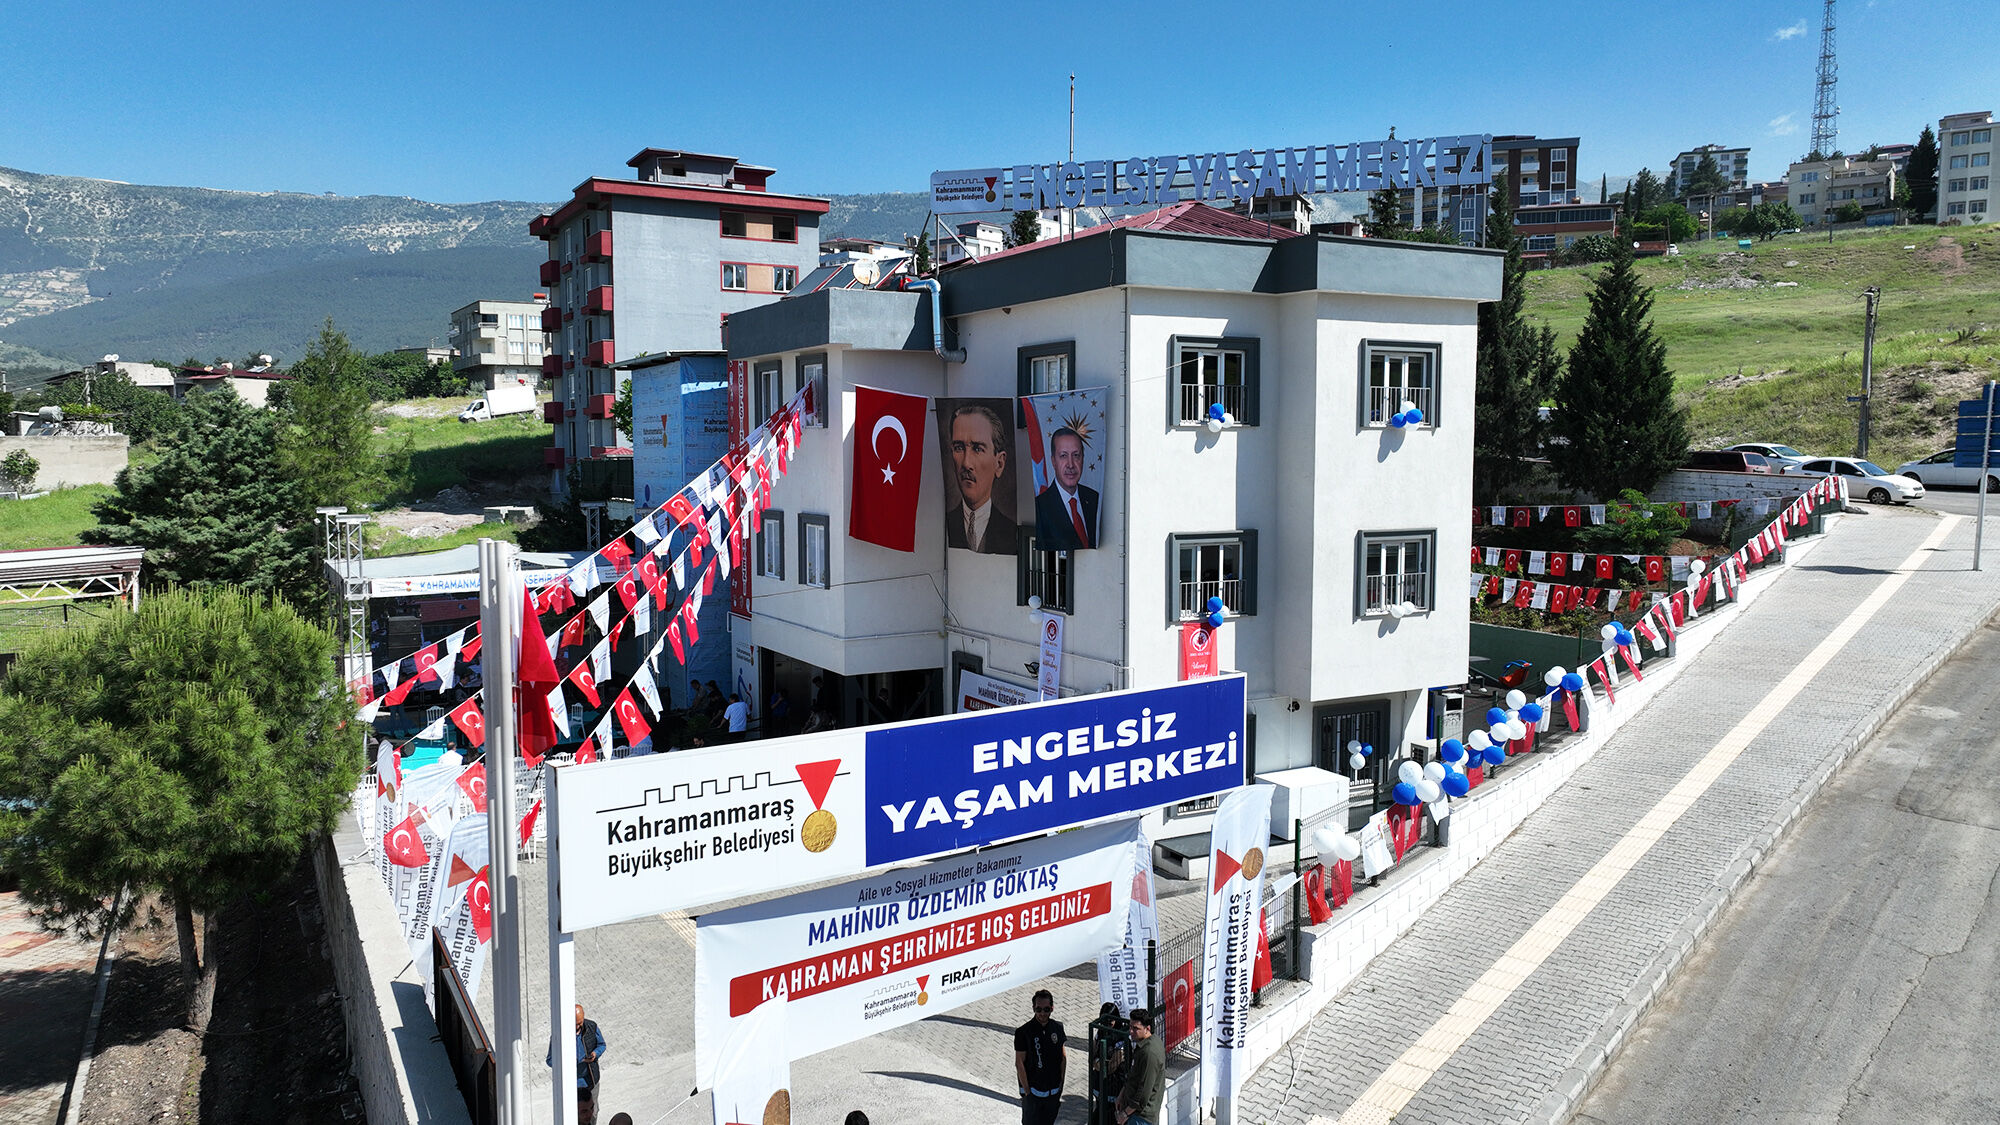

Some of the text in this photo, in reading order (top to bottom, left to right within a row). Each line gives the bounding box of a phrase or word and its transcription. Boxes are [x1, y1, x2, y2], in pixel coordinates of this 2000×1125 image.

[1012, 133, 1493, 211] ENGELSİZ YAŞAM MERKEZİ
[420, 578, 481, 590] KAHRAMANMA
[973, 707, 1177, 774] ENGELSİZ
[881, 731, 1238, 834] YAŞAM MERKEZİ
[607, 798, 795, 846] Kahramanmaraş
[608, 824, 795, 877] Büyükşehir Belediyesi
[808, 863, 1059, 947] MAHİNUR ÖZDEMİR GÖKTAŞ
[858, 855, 1022, 903] Aile ve Sosyal Hizmetler Bakanımız
[762, 892, 1091, 1001] KAHRAMAN ŞEHRİMİZE HOŞ GELDİNİZ
[1217, 893, 1241, 1051] Kahramanmaraş
[864, 989, 917, 1011] Kahramanmaraş
[941, 966, 979, 987] FIRAT
[864, 999, 917, 1020] Büyükşehir Belediyesi
